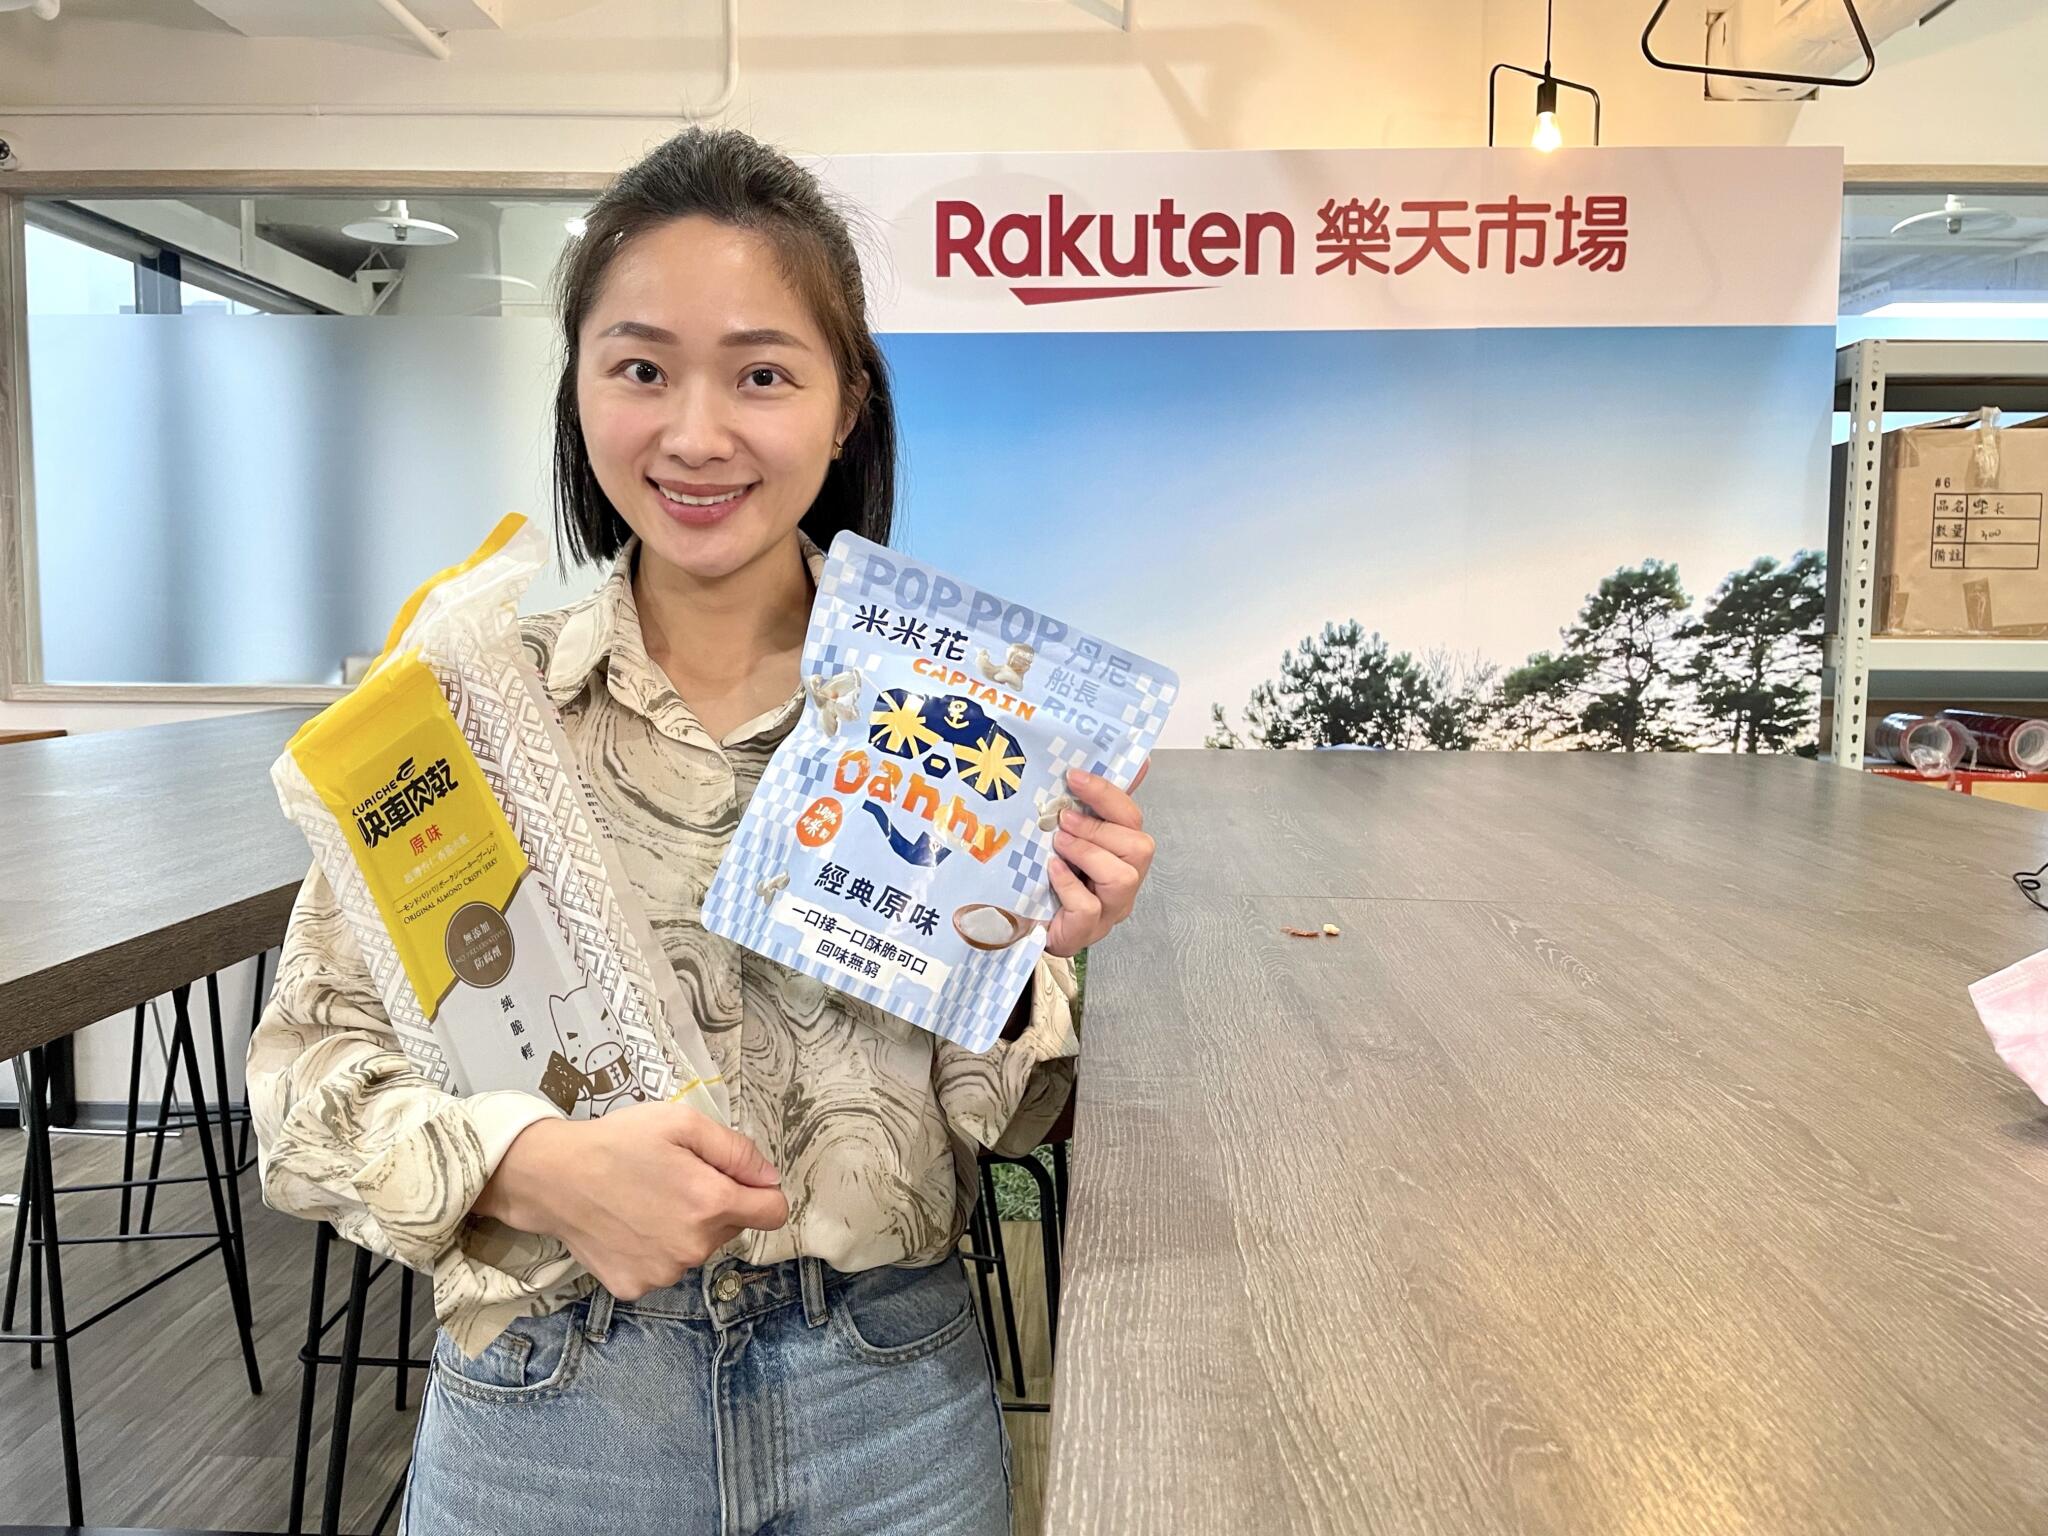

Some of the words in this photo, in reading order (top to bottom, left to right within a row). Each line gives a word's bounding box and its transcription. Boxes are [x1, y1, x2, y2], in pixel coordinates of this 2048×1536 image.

[936, 194, 1296, 278] Rakuten
[1315, 194, 1629, 276] 樂天市場
[1936, 499, 1964, 513] 品名
[851, 604, 969, 661] 米米花
[859, 554, 963, 619] POP
[965, 590, 1069, 655] POP
[912, 657, 1038, 722] CAPTAIN
[1044, 666, 1101, 709] 船長
[1064, 637, 1133, 688] 丹尼
[1041, 695, 1121, 753] RICE
[352, 779, 398, 817] KUAICHE
[356, 758, 459, 848] 快車肉乾
[409, 824, 443, 856] 原味
[403, 902, 436, 925] ORIGINAL
[436, 883, 463, 904] ALMOND
[814, 861, 941, 936] 經典原味
[792, 906, 929, 975] 一口接一口酥脆可口
[816, 938, 881, 979] 回味無窮
